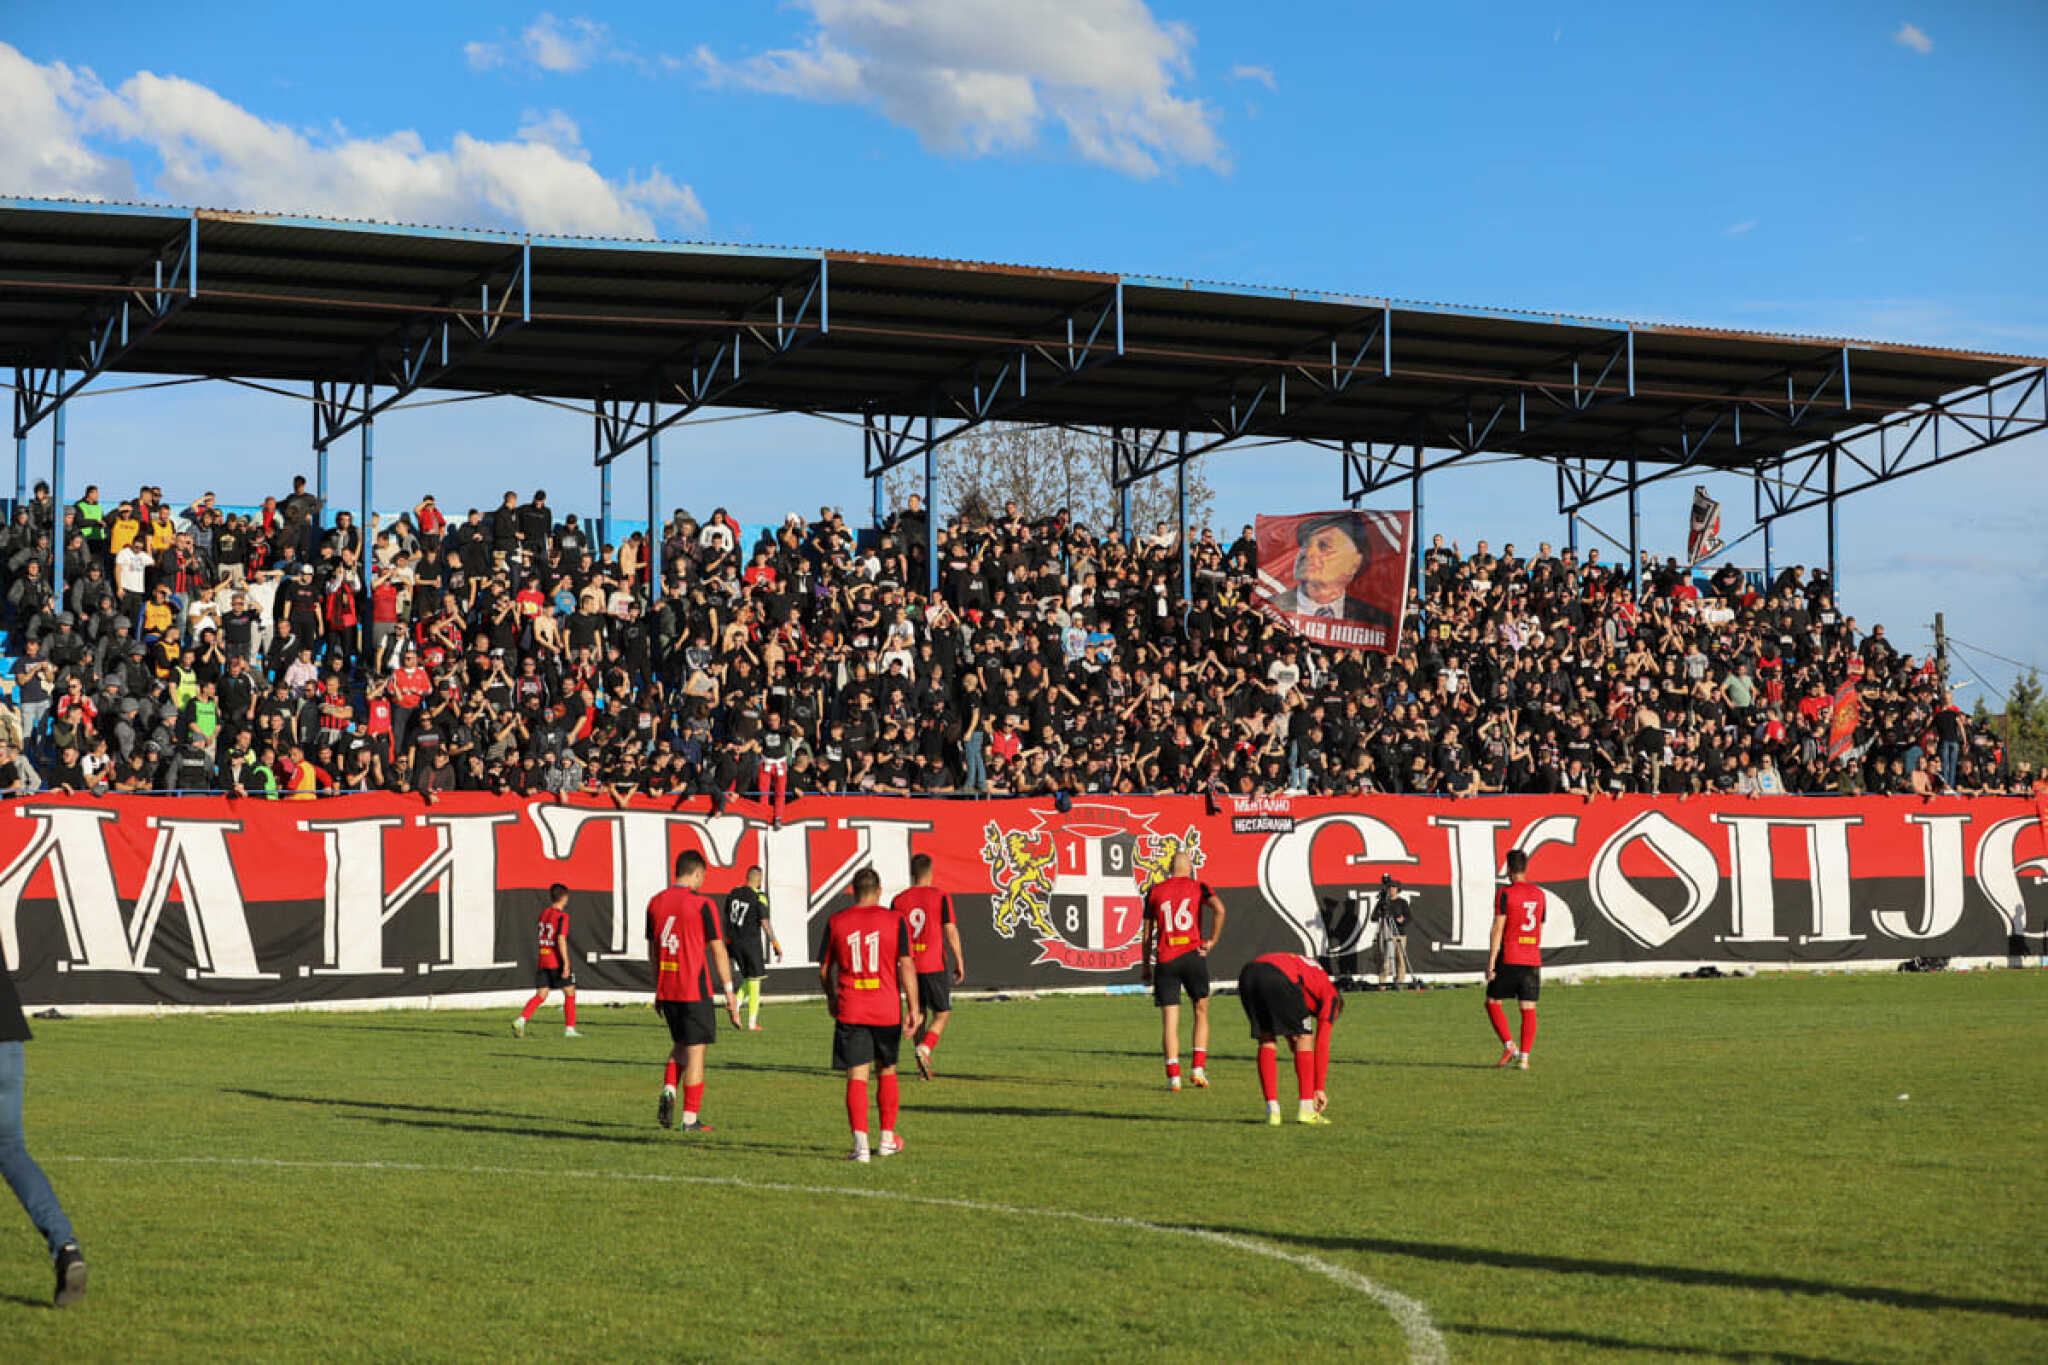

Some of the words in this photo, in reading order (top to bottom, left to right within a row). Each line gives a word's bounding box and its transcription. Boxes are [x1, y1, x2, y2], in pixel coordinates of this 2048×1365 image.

[1066, 841, 1077, 869] 1
[1110, 844, 1125, 871] 9
[729, 899, 750, 927] 87
[909, 907, 926, 940] 9
[1065, 905, 1080, 932] 8
[1112, 907, 1129, 934] 7
[1160, 898, 1194, 933] 16
[1520, 901, 1538, 932] 3
[660, 915, 680, 956] 4
[846, 929, 880, 974] 11
